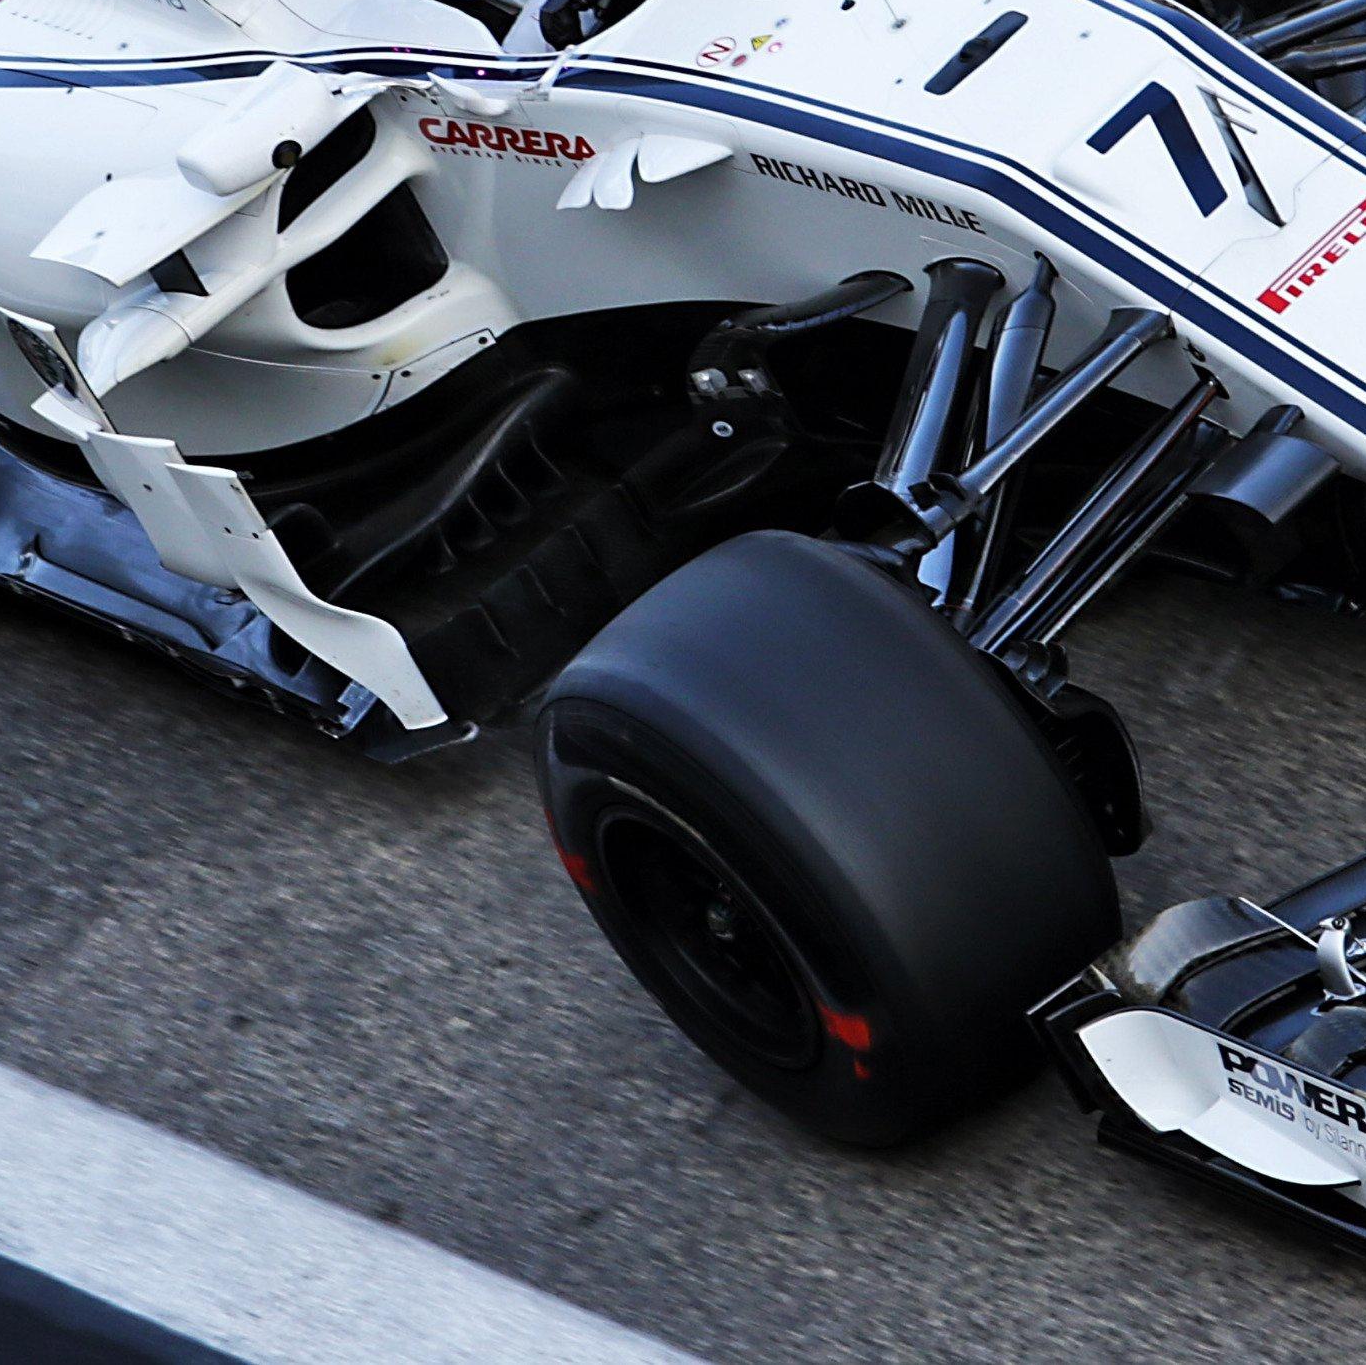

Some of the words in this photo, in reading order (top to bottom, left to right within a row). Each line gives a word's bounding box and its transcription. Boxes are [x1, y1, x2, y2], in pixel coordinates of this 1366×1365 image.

[418, 117, 596, 161] CARRERA
[1086, 80, 1228, 218] 7
[750, 153, 887, 208] RICHARD
[890, 190, 987, 235] MILLE
[1304, 1112, 1321, 1141] by
